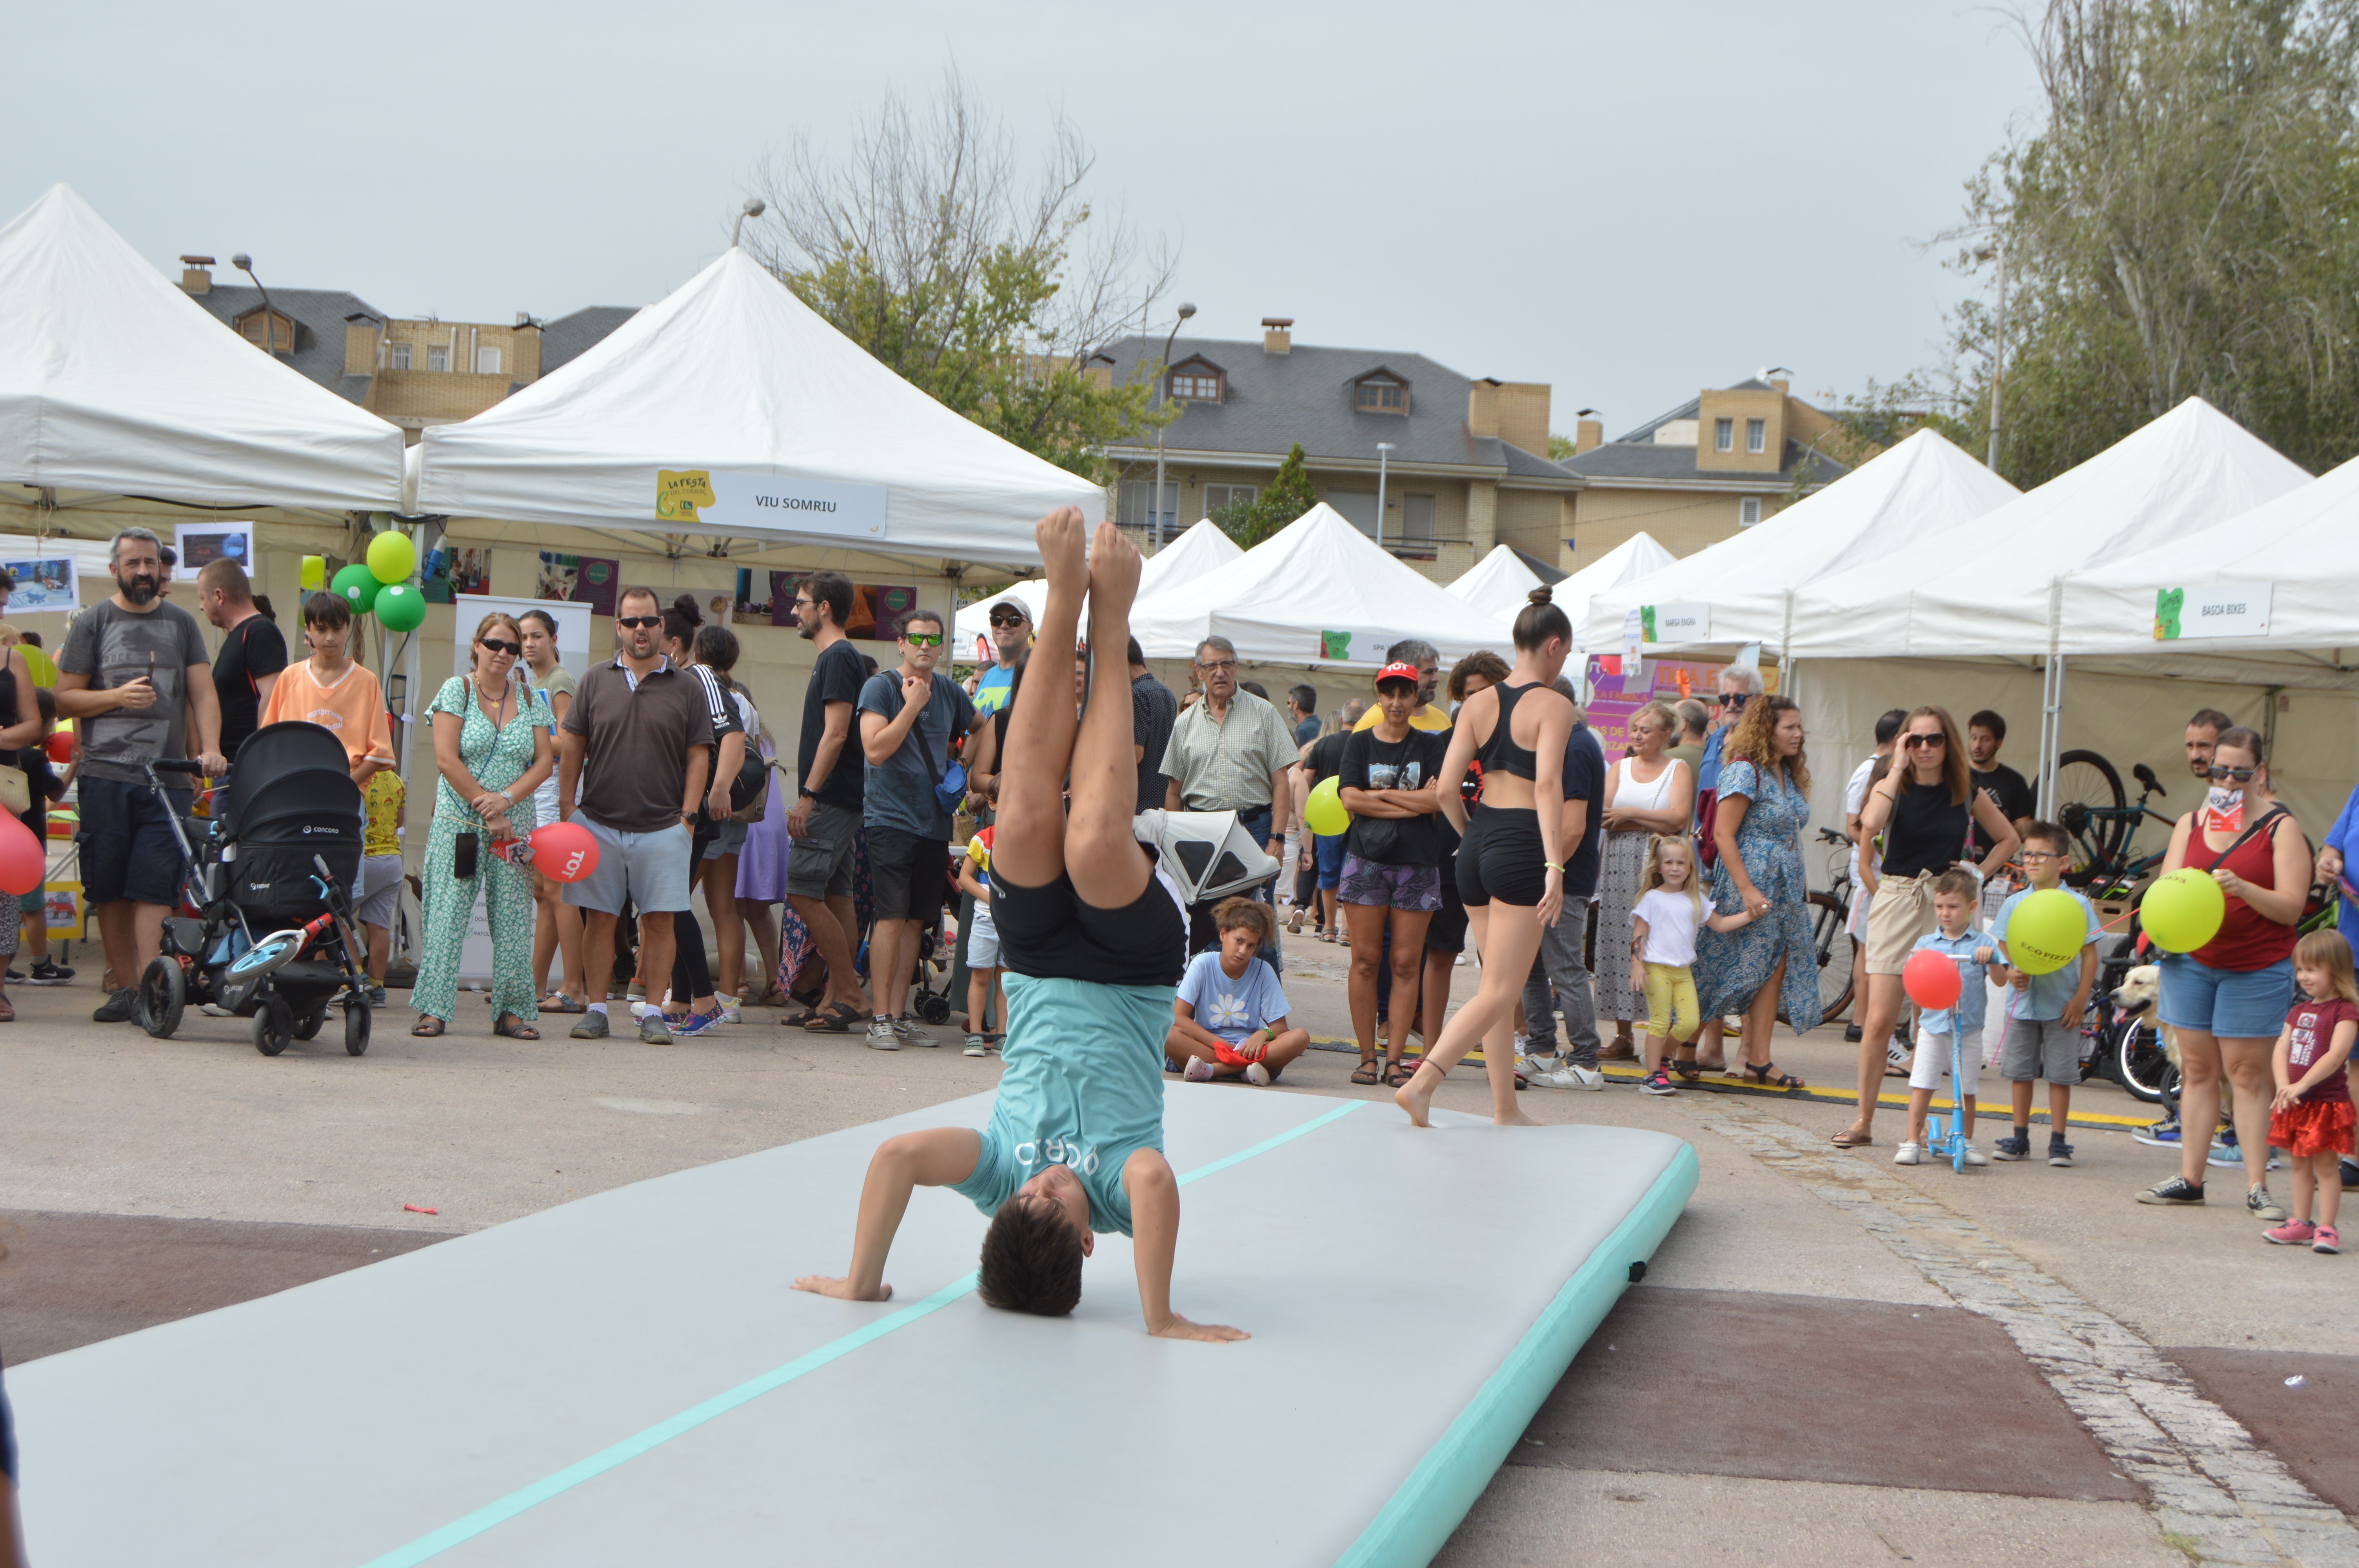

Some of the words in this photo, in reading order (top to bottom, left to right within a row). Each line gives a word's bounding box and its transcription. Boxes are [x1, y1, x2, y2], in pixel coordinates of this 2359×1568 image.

[668, 481, 678, 489] LA
[680, 477, 706, 488] FESTA
[756, 495, 778, 507] VIU
[783, 498, 836, 512] SOMRIU
[2202, 605, 2225, 617] BASOA
[2226, 603, 2246, 615] BIKES
[1666, 619, 1680, 627] MARGA
[105, 652, 132, 662] ROCK
[1387, 662, 1408, 671] TOT
[1610, 727, 1625, 737] DE
[562, 850, 585, 878] TOT
[2021, 942, 2043, 955] ECO
[2043, 952, 2071, 960] PIZZA
